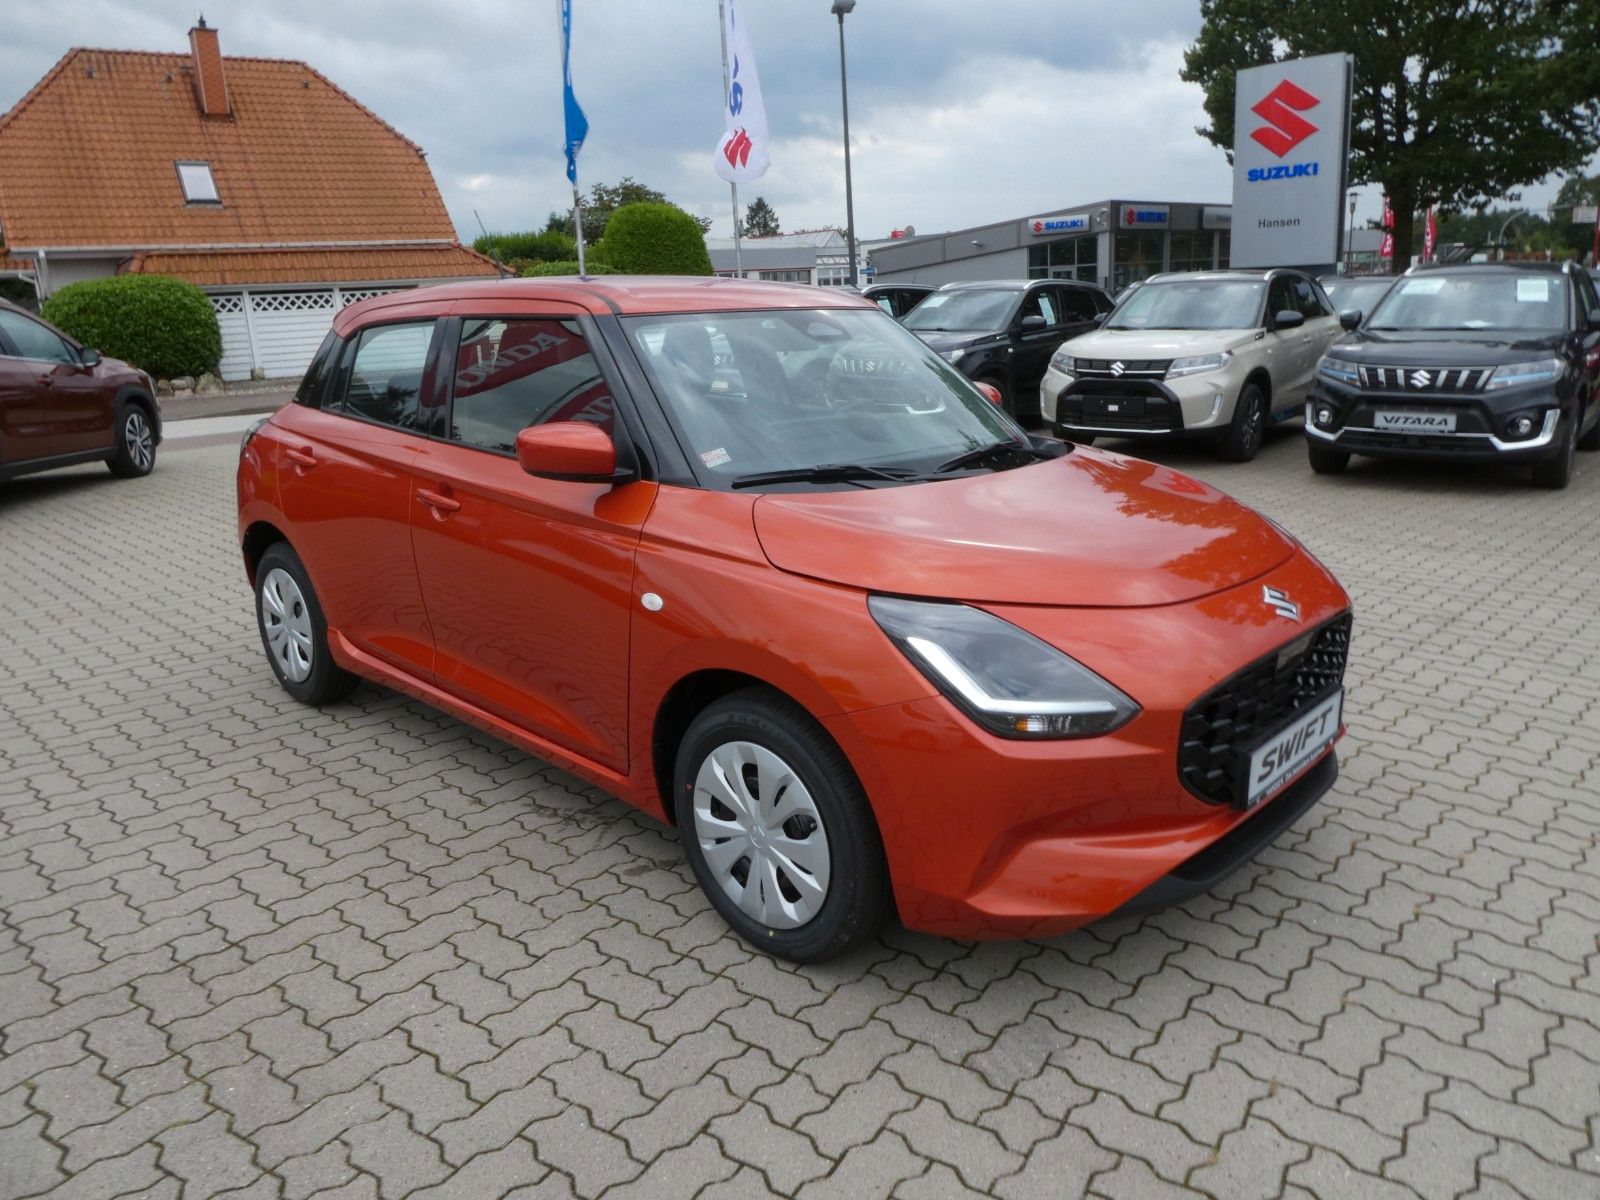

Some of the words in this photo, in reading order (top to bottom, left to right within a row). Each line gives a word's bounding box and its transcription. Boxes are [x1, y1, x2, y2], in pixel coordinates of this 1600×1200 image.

[1247, 162, 1319, 182] SUZUKI
[1136, 210, 1167, 224] SUZUKI
[1257, 217, 1301, 229] Hansen
[1044, 219, 1084, 230] SUZUKI
[455, 332, 569, 388] ONDA
[1382, 415, 1448, 426] VITARA
[1257, 705, 1334, 784] SWIFT
